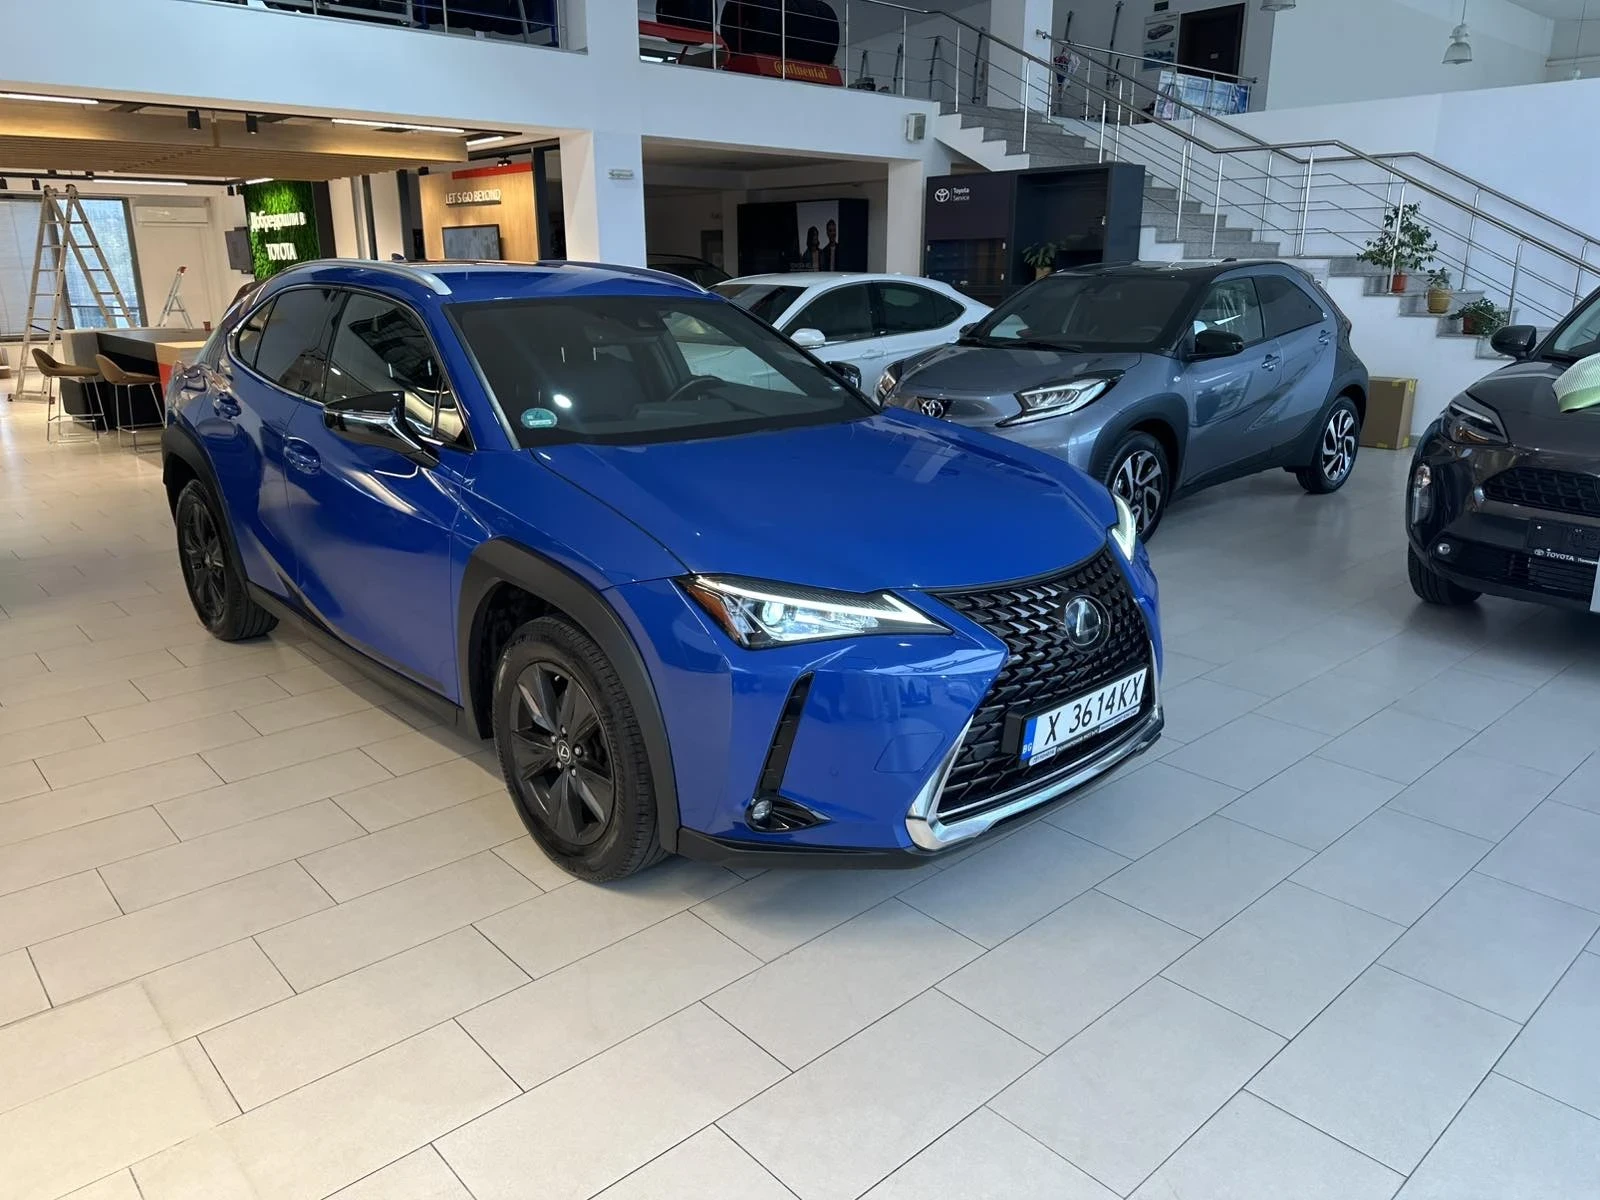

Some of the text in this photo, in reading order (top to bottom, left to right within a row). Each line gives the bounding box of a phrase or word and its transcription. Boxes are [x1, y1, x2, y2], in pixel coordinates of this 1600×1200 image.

[462, 191, 473, 202] GO
[473, 188, 501, 202] BEYOND
[265, 242, 298, 261] TOYOTA
[1546, 551, 1574, 562] TOYOTA
[1022, 742, 1034, 754] BG
